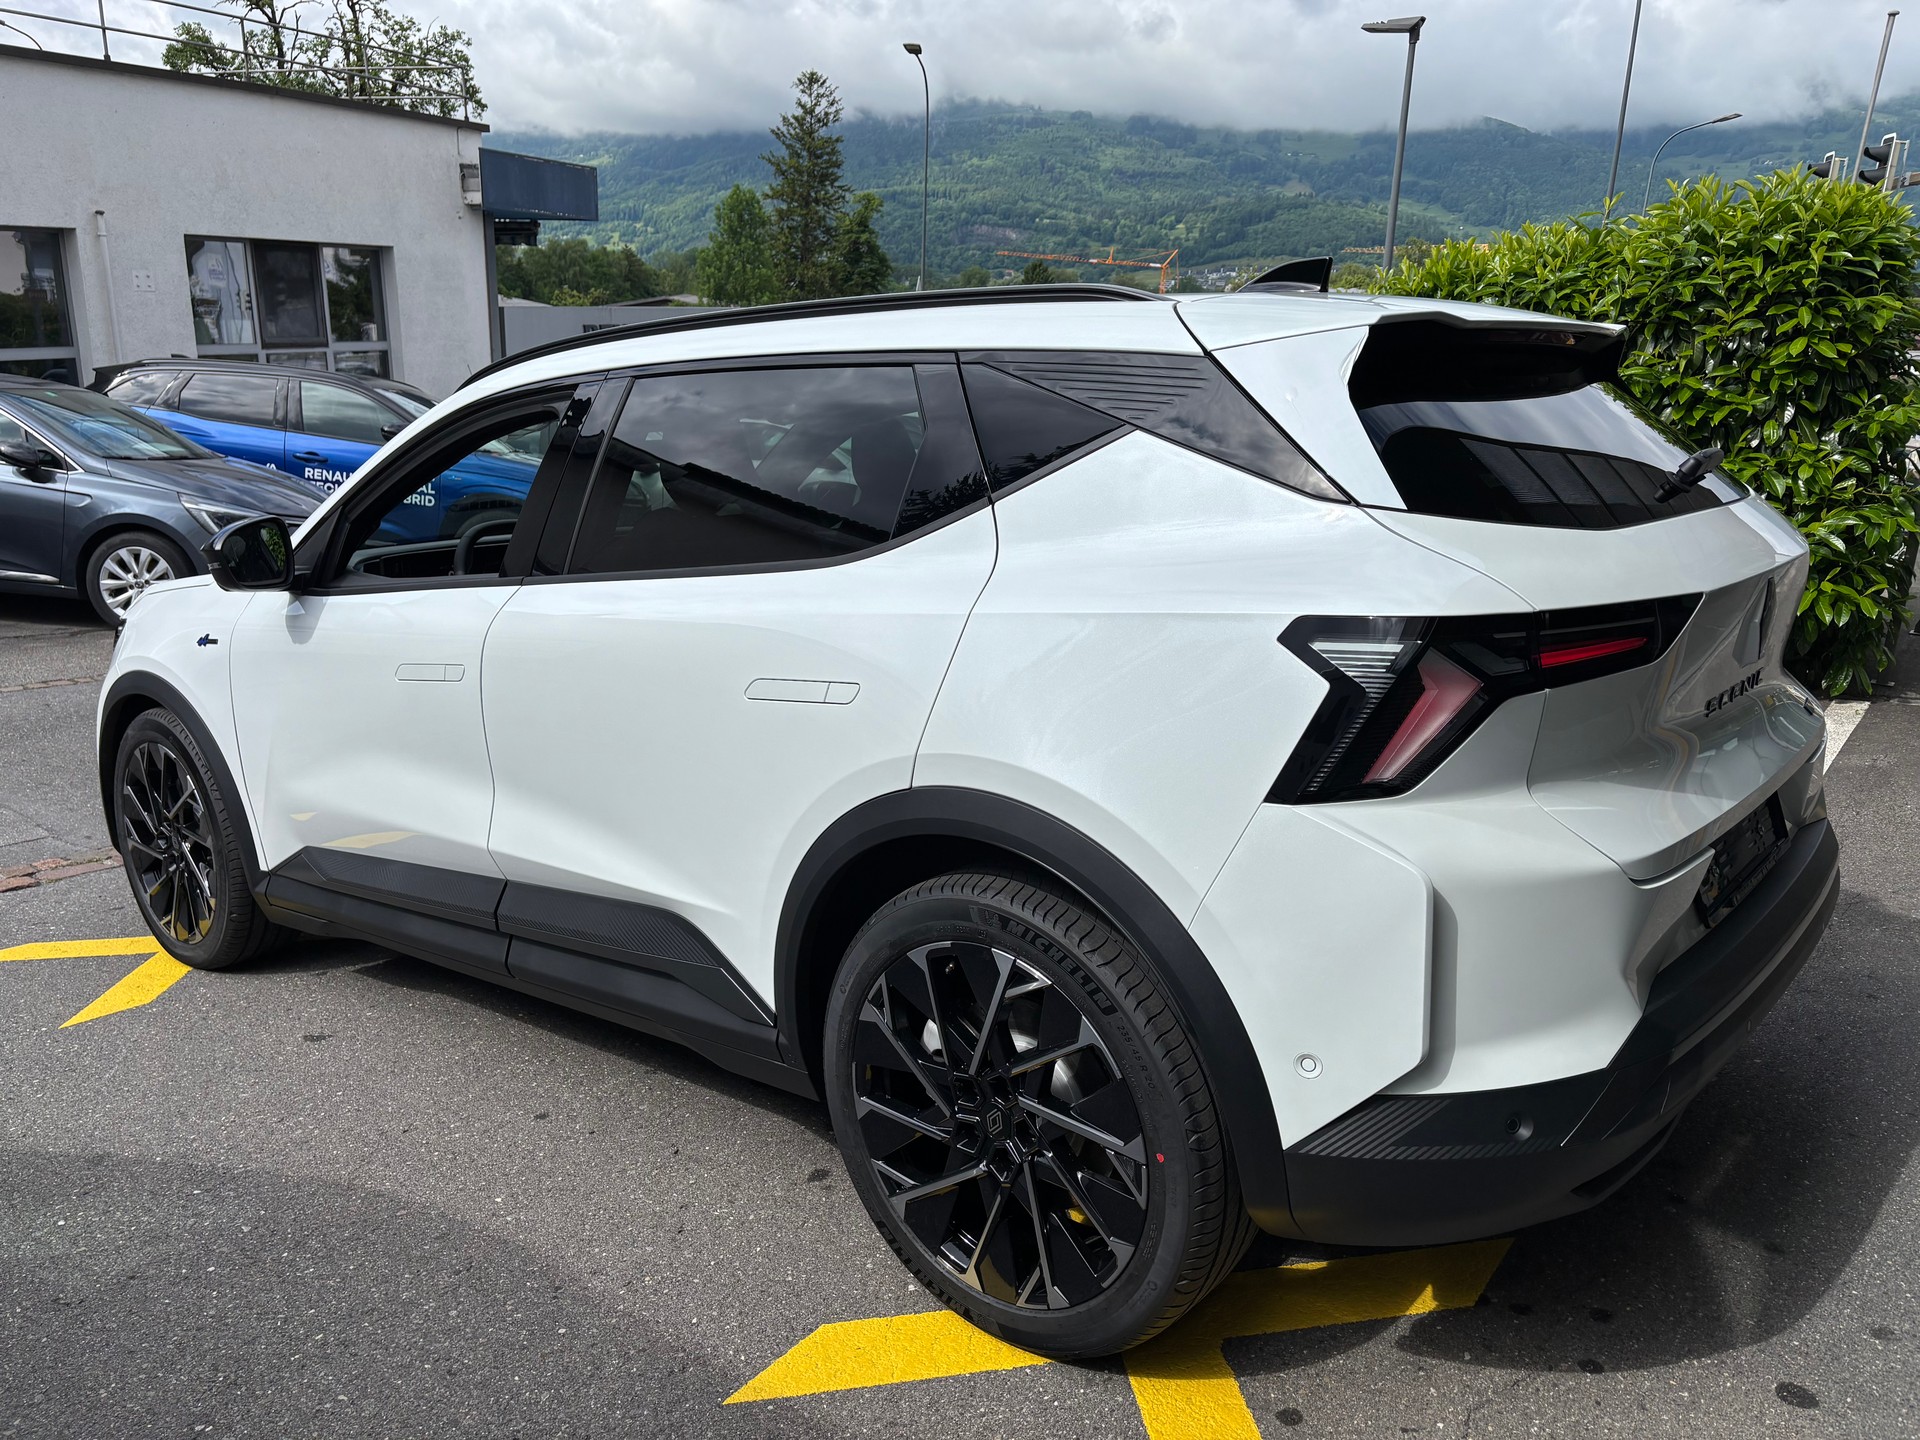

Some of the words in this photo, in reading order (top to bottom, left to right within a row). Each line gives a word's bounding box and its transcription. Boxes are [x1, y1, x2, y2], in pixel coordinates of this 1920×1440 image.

[304, 467, 353, 482] RENAU
[403, 494, 436, 507] BRID
[1703, 666, 1764, 718] SCENIC
[1006, 918, 1114, 1011] MICHELIN
